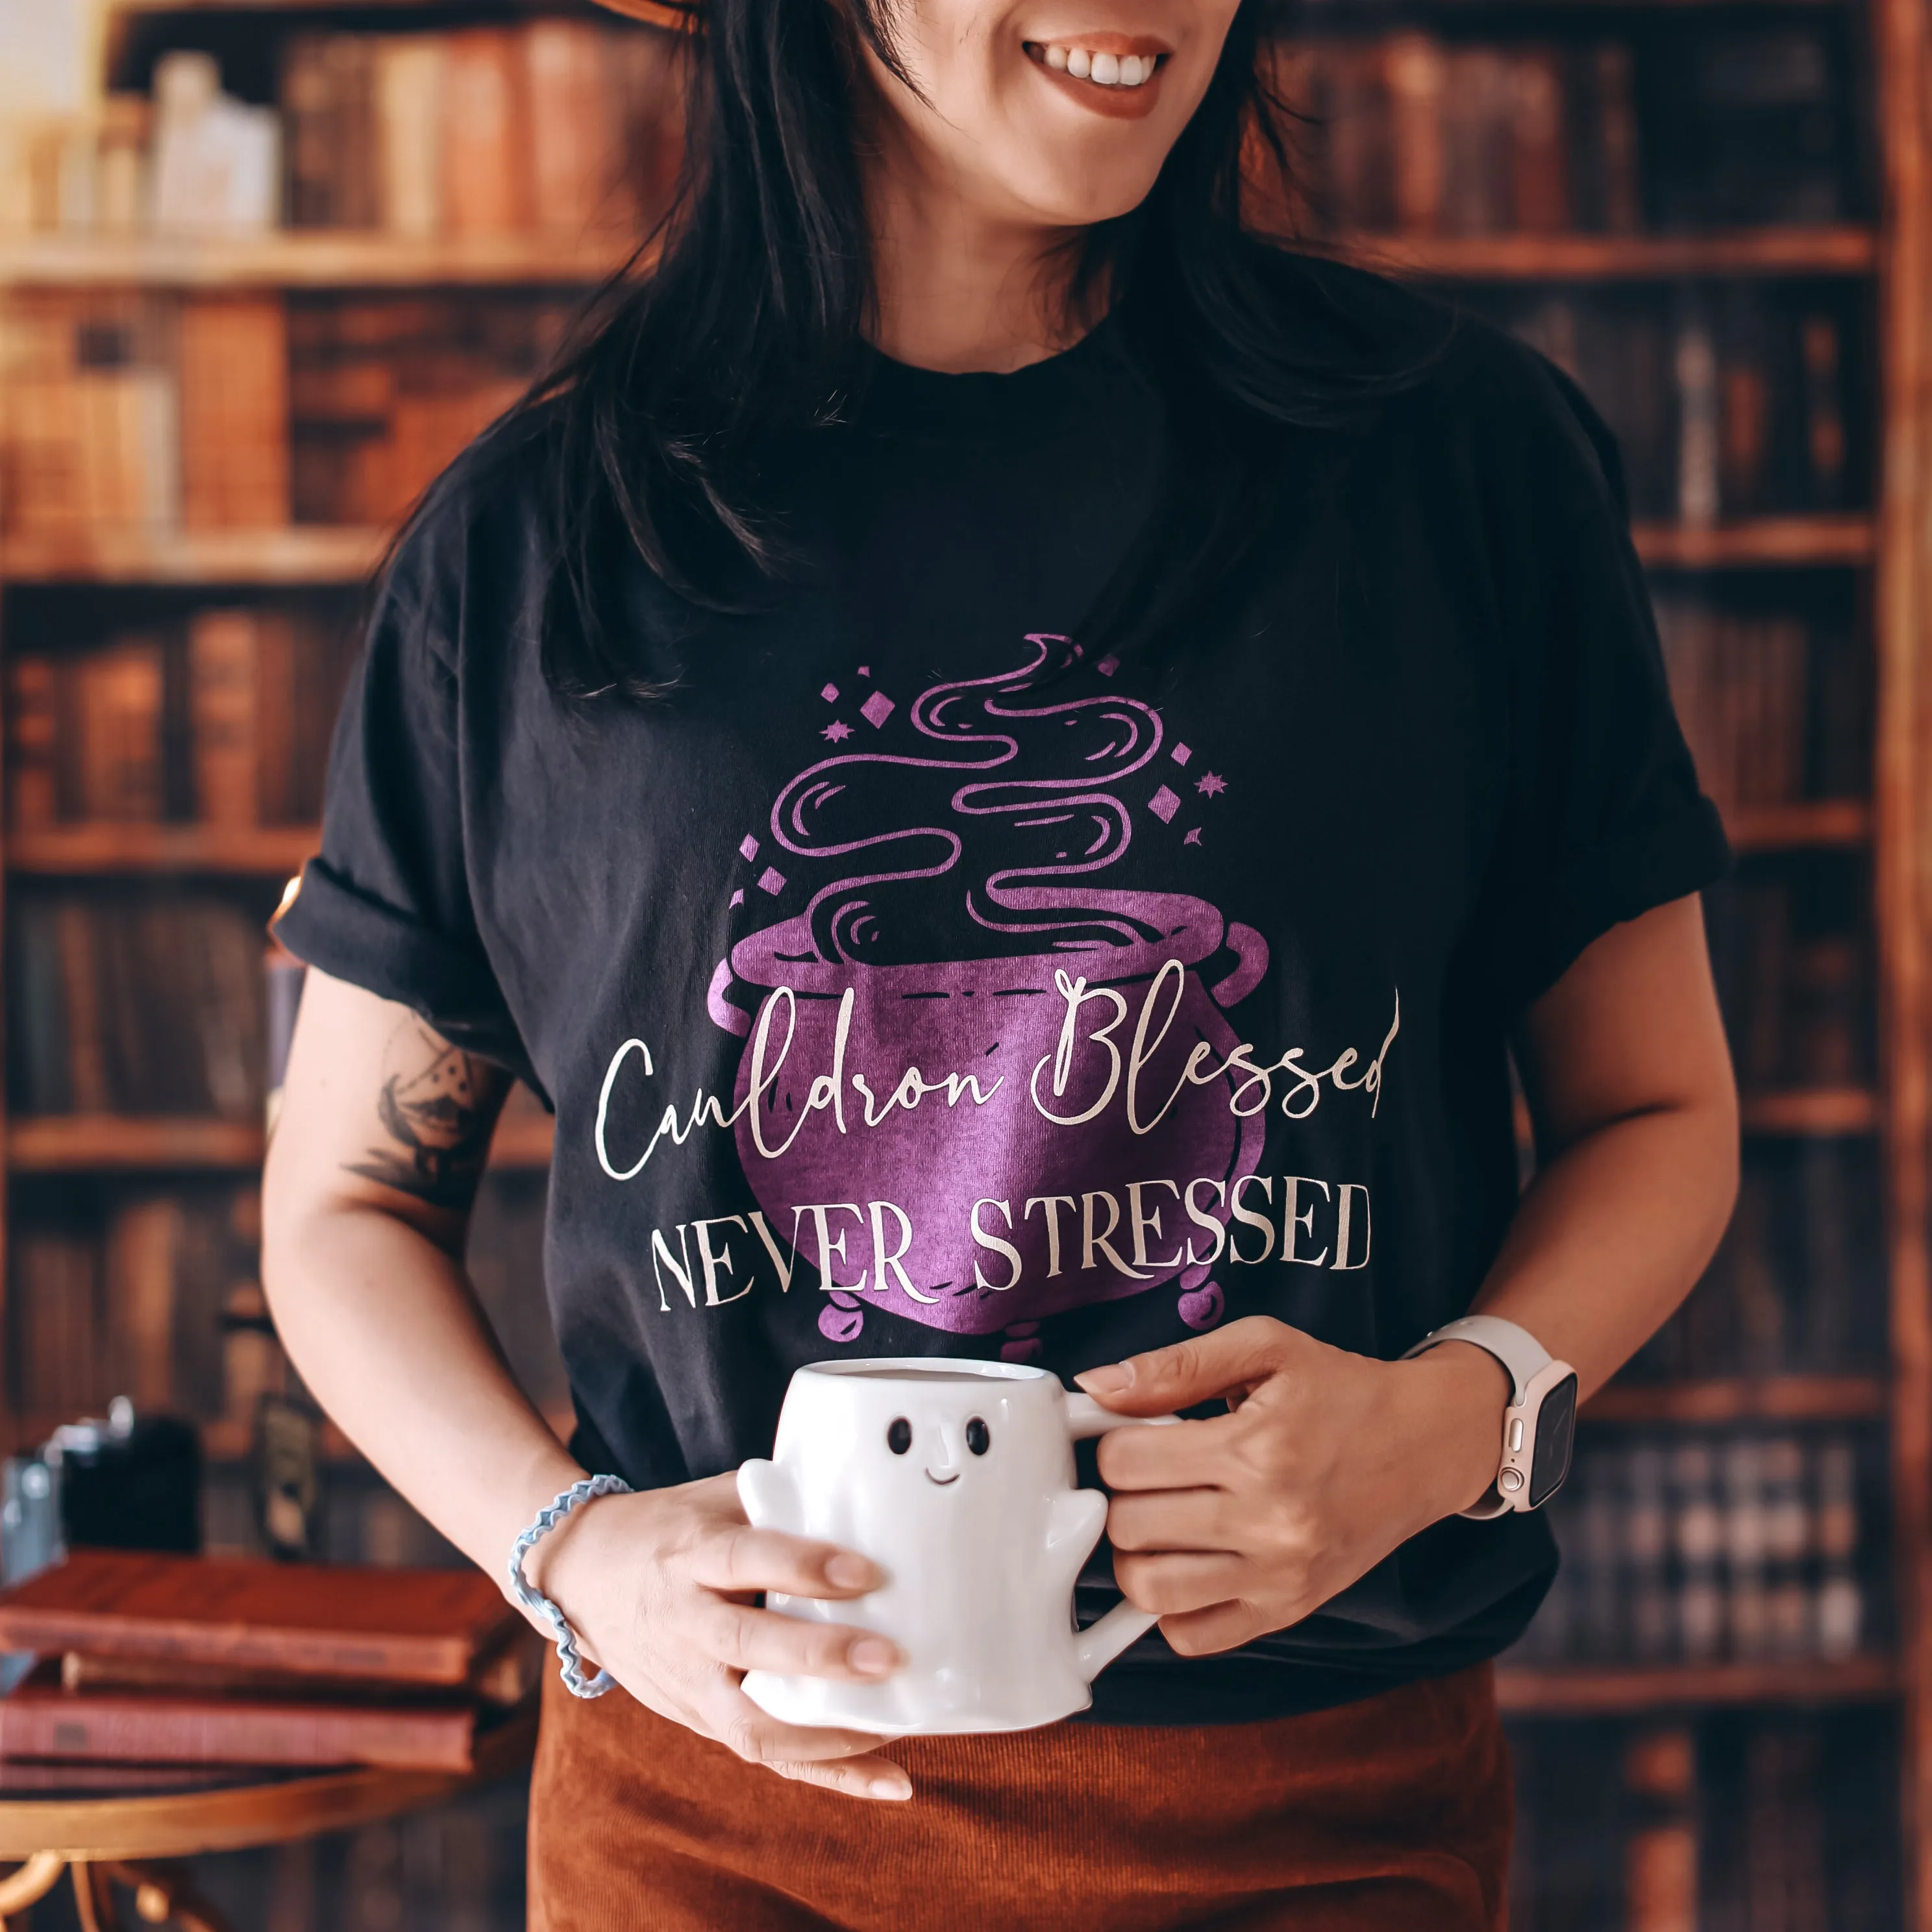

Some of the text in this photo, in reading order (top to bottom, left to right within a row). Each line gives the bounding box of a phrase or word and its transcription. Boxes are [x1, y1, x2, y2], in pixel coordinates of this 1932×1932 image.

[596, 960, 1399, 1180] Cauldron Blessed
[651, 1176, 1371, 1310] NEVER STRESSED
